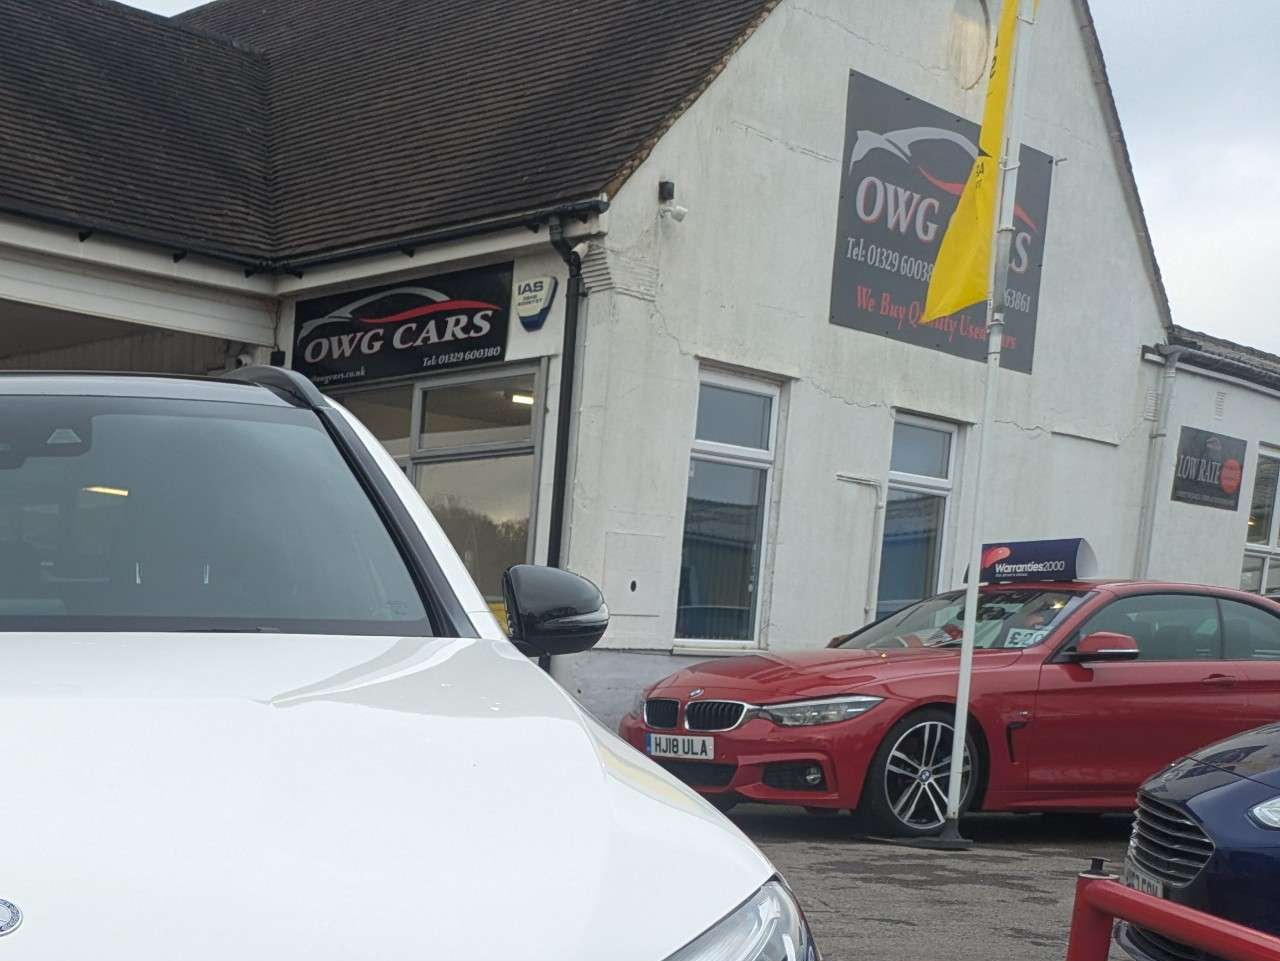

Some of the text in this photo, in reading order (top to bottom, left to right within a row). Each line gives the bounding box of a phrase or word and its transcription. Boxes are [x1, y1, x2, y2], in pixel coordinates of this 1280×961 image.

[855, 176, 940, 242] OWG
[847, 237, 866, 261] Tel:
[867, 245, 900, 272] 01329
[518, 280, 544, 296] IAS
[856, 285, 877, 312] We
[879, 293, 906, 331] Buy
[304, 310, 494, 364] OWG CARS
[438, 351, 464, 365] 01329
[464, 345, 501, 361] 600380
[654, 736, 708, 757] HJ18 ULA
